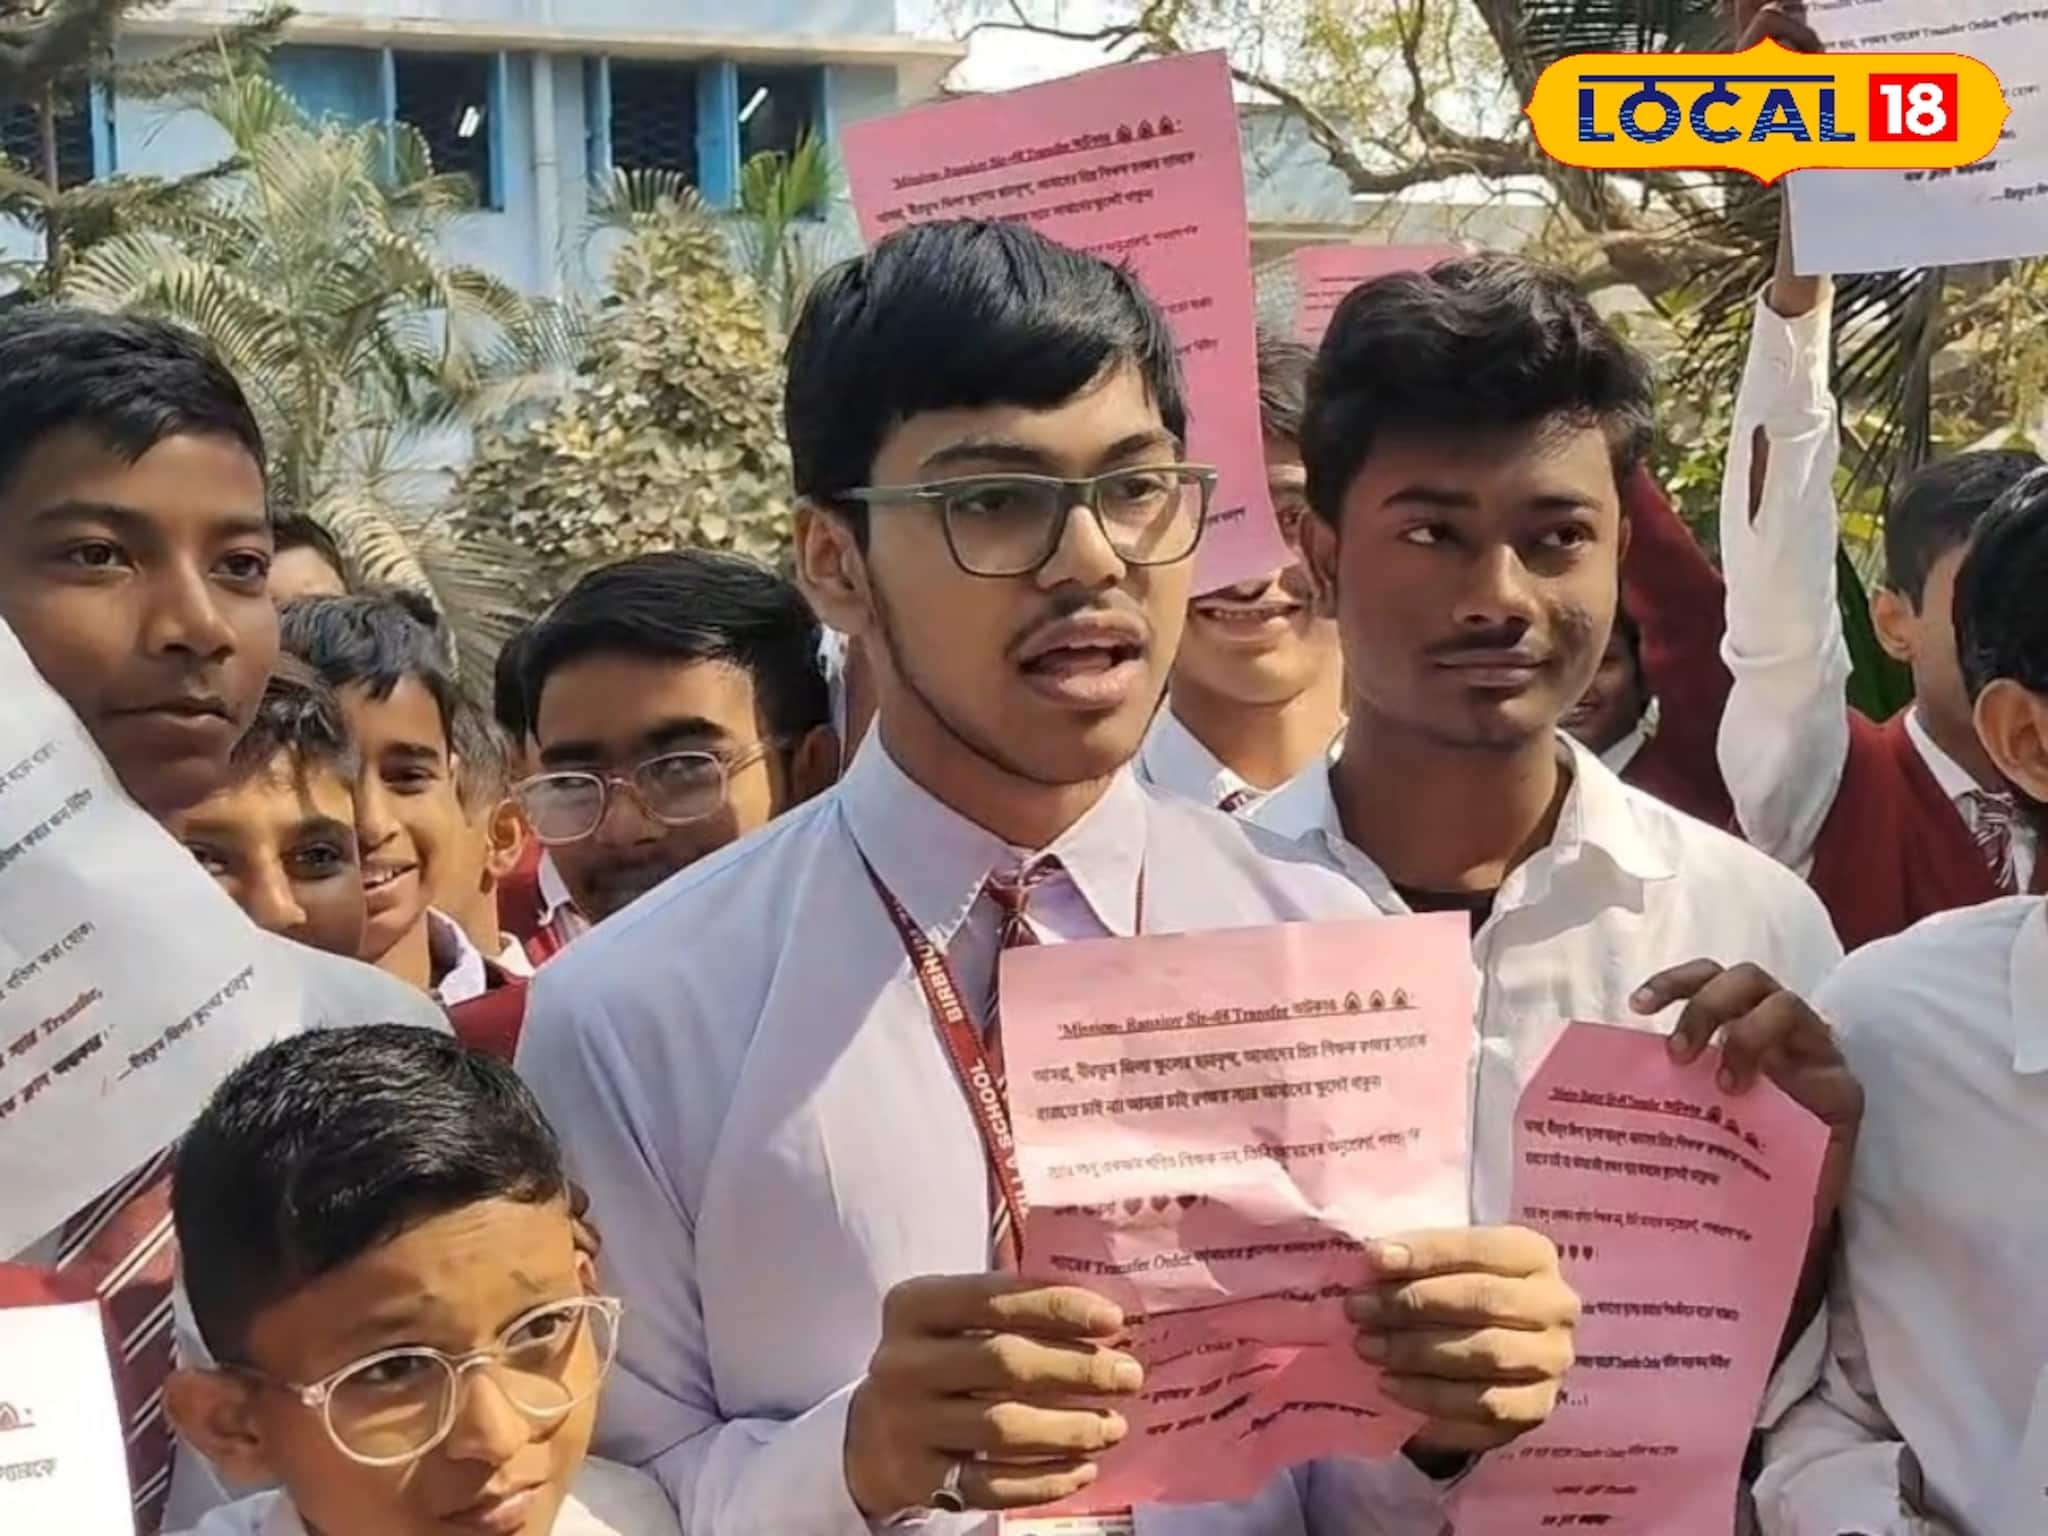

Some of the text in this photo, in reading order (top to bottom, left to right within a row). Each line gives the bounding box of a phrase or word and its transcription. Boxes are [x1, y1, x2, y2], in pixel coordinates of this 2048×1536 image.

[1233, 1003, 1289, 1022] Transfer
[969, 1056, 1012, 1150] SCHOOL
[1095, 1257, 1150, 1276] Transfer
[1152, 1252, 1193, 1271] Order
